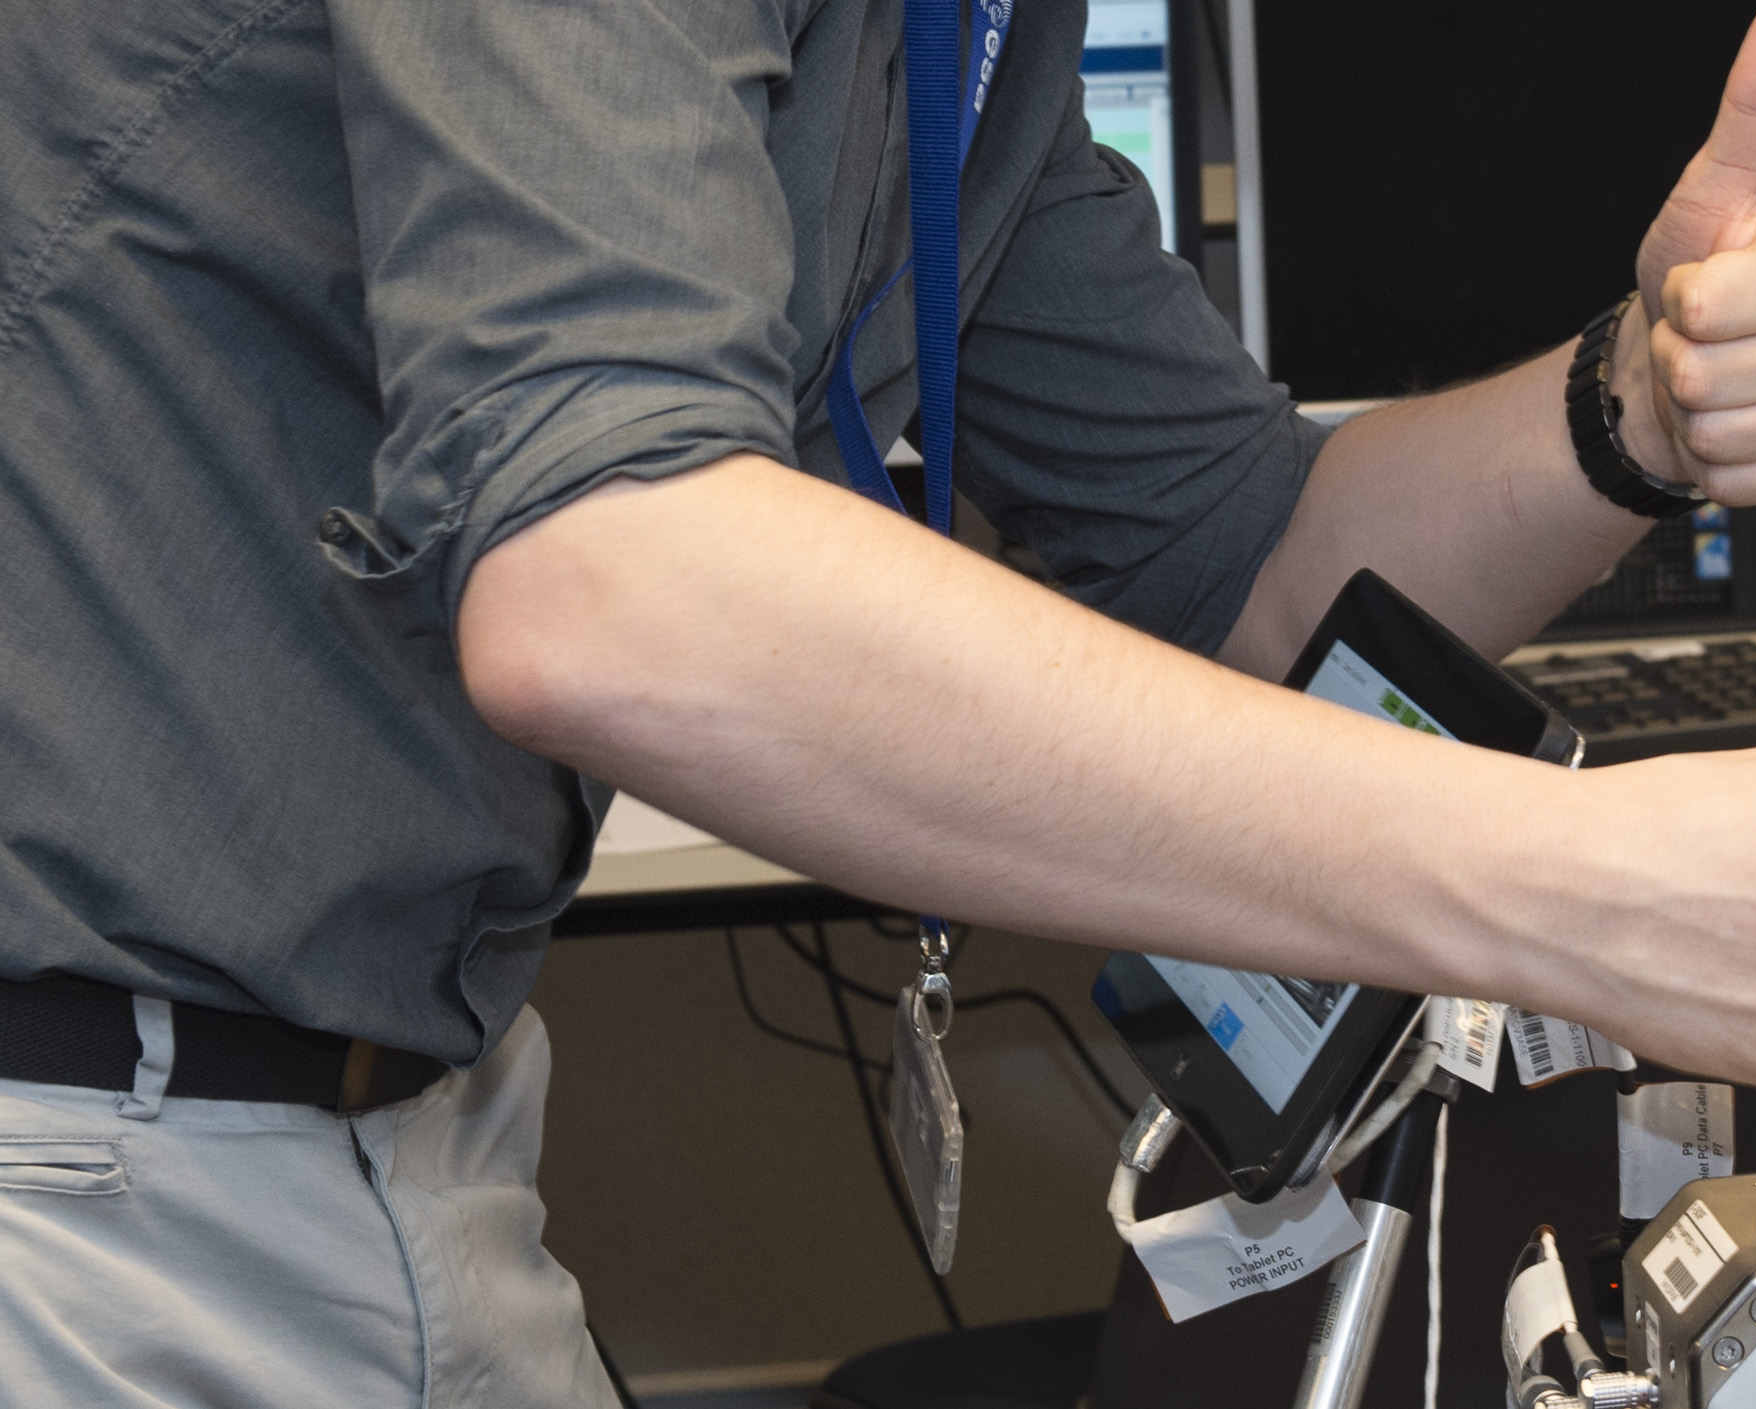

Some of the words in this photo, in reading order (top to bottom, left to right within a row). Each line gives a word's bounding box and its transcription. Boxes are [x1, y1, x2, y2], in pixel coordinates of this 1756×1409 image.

[1695, 1084, 1709, 1115] Cable
[1696, 1117, 1709, 1142] Data
[1682, 1142, 1693, 1156] P9
[1697, 1143, 1709, 1160] PC
[1713, 1142, 1724, 1157] P7
[1244, 1243, 1261, 1257] P5
[1226, 1265, 1242, 1276] To
[1241, 1254, 1277, 1273] Tablet
[1276, 1246, 1295, 1261] PC
[1229, 1272, 1269, 1290] POWER
[1269, 1257, 1305, 1279] INPUT
